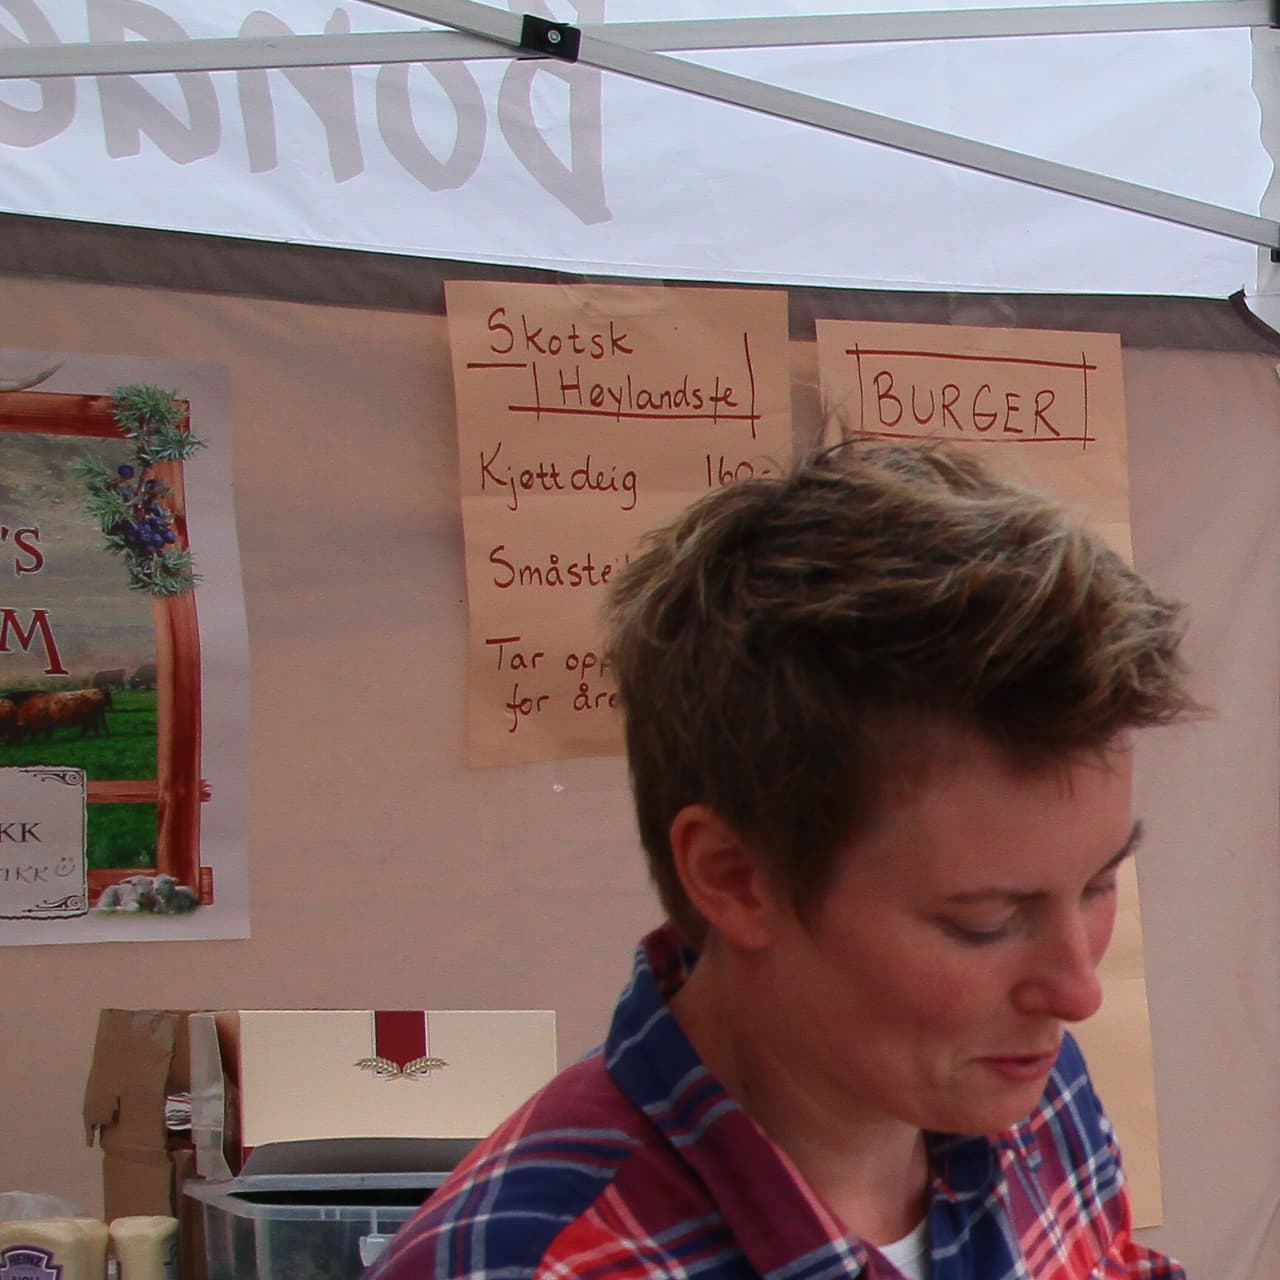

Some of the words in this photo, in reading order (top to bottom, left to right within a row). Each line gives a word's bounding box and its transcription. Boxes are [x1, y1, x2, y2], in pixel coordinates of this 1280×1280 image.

[487, 307, 634, 359] Skotsk
[873, 370, 1061, 438] BURGER
[485, 636, 545, 671] Tar
[506, 682, 550, 733] for
